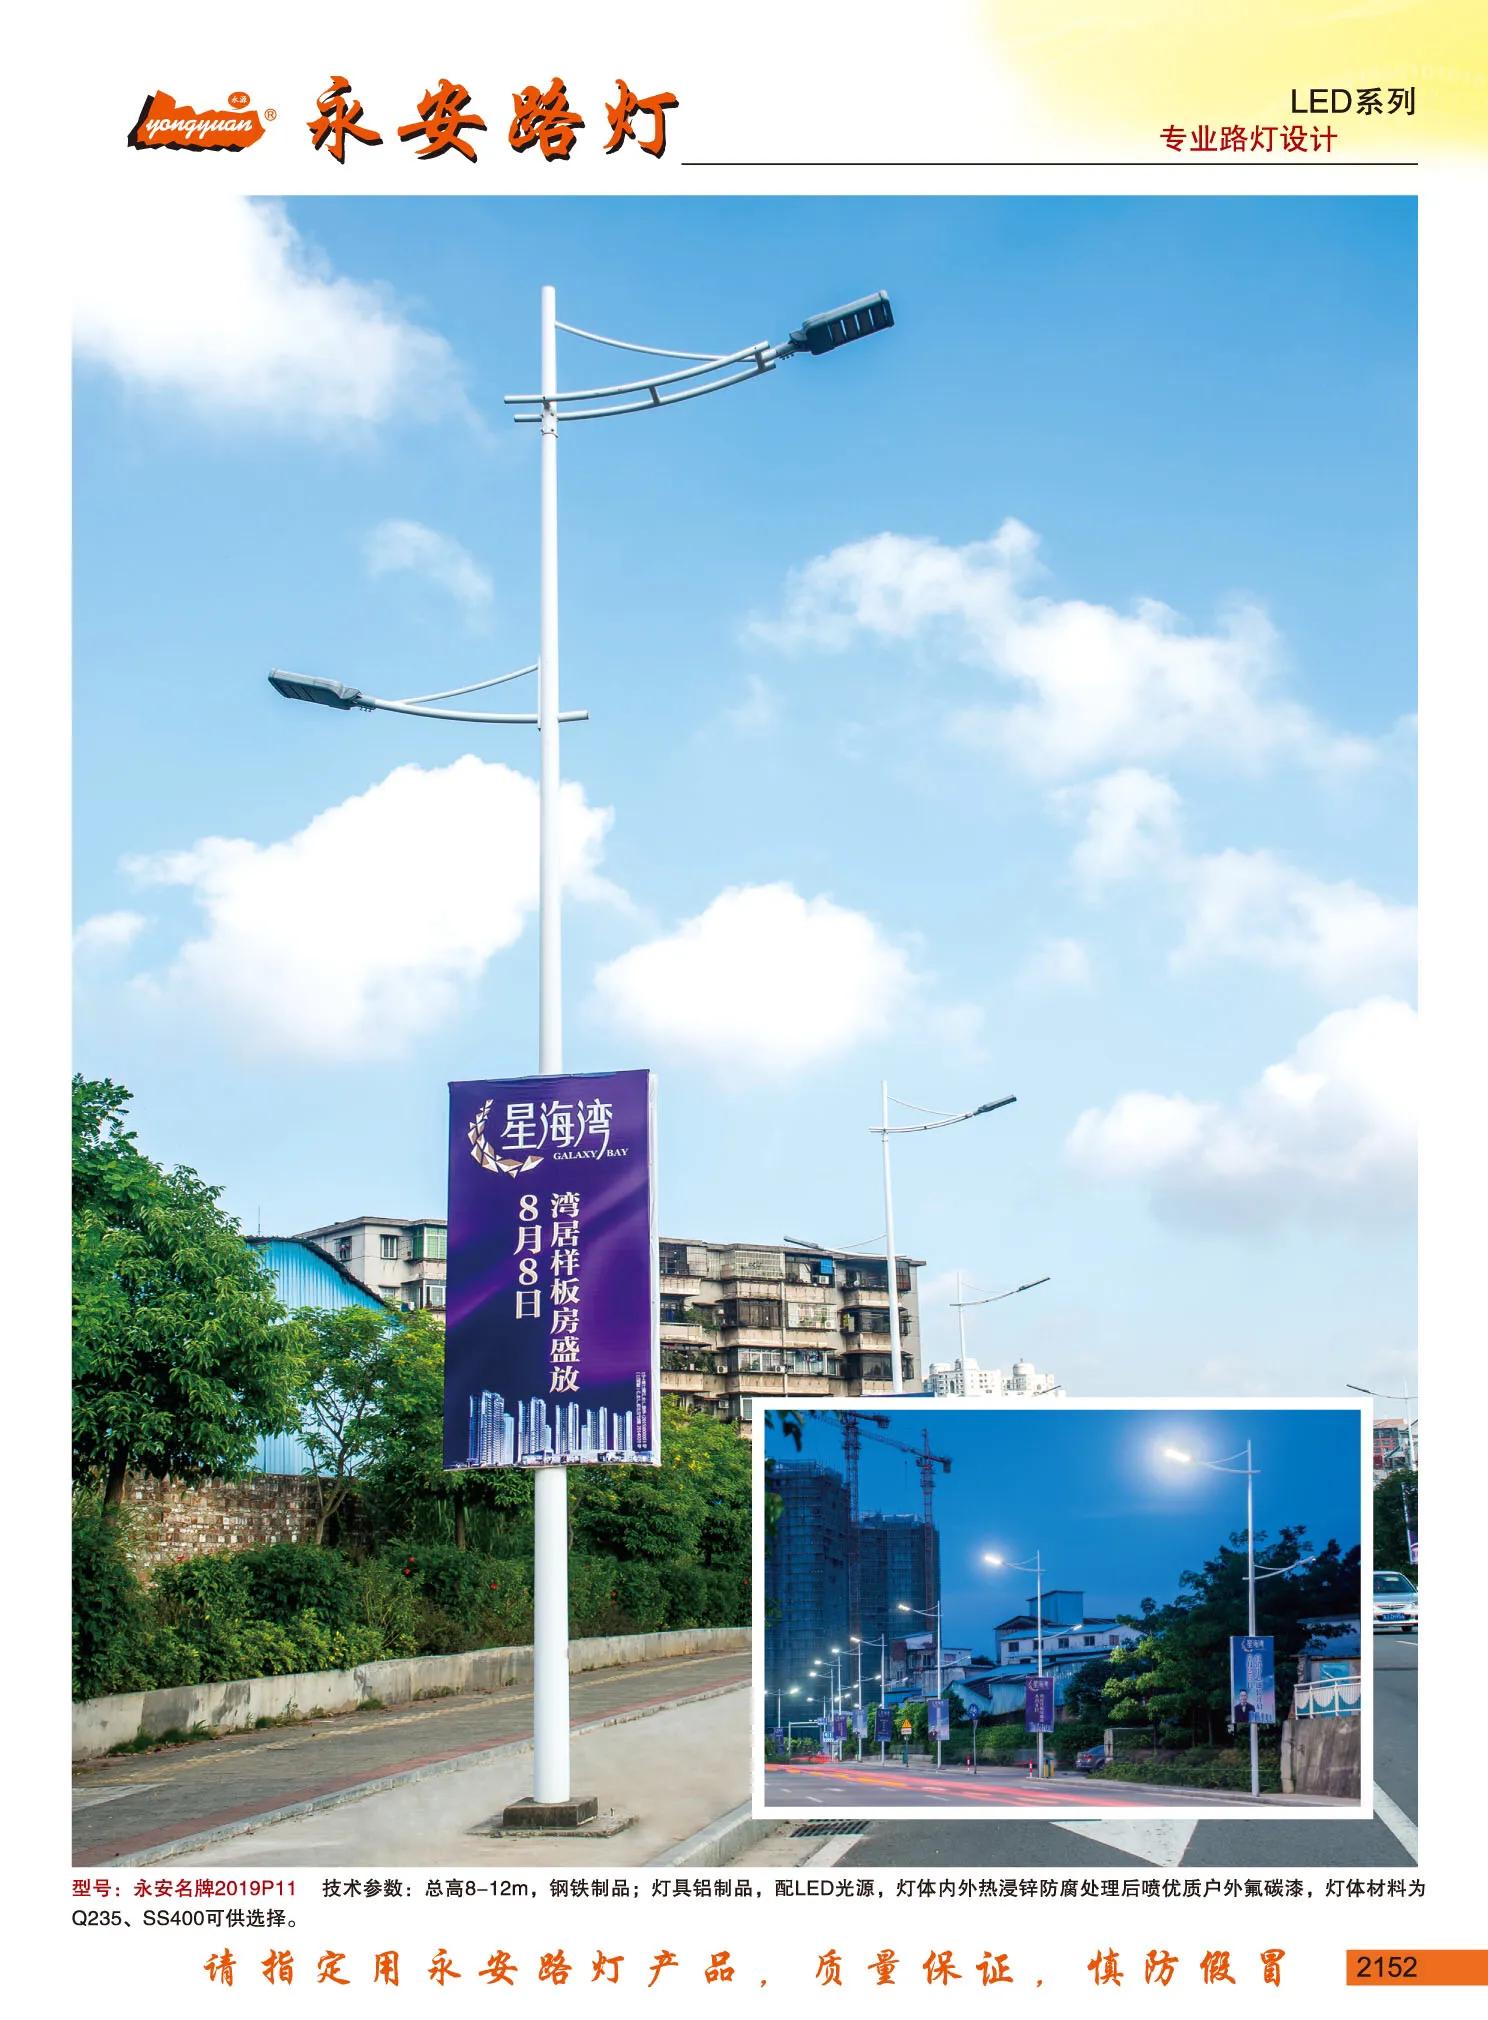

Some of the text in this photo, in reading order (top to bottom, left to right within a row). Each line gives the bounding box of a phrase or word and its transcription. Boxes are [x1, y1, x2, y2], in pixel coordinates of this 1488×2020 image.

[500, 1098, 614, 1161] 星海湾
[553, 1148, 629, 1161] GALAXY BAY
[513, 1194, 543, 1320] 8月8日
[549, 1191, 581, 1394] 湾居样板房盛放
